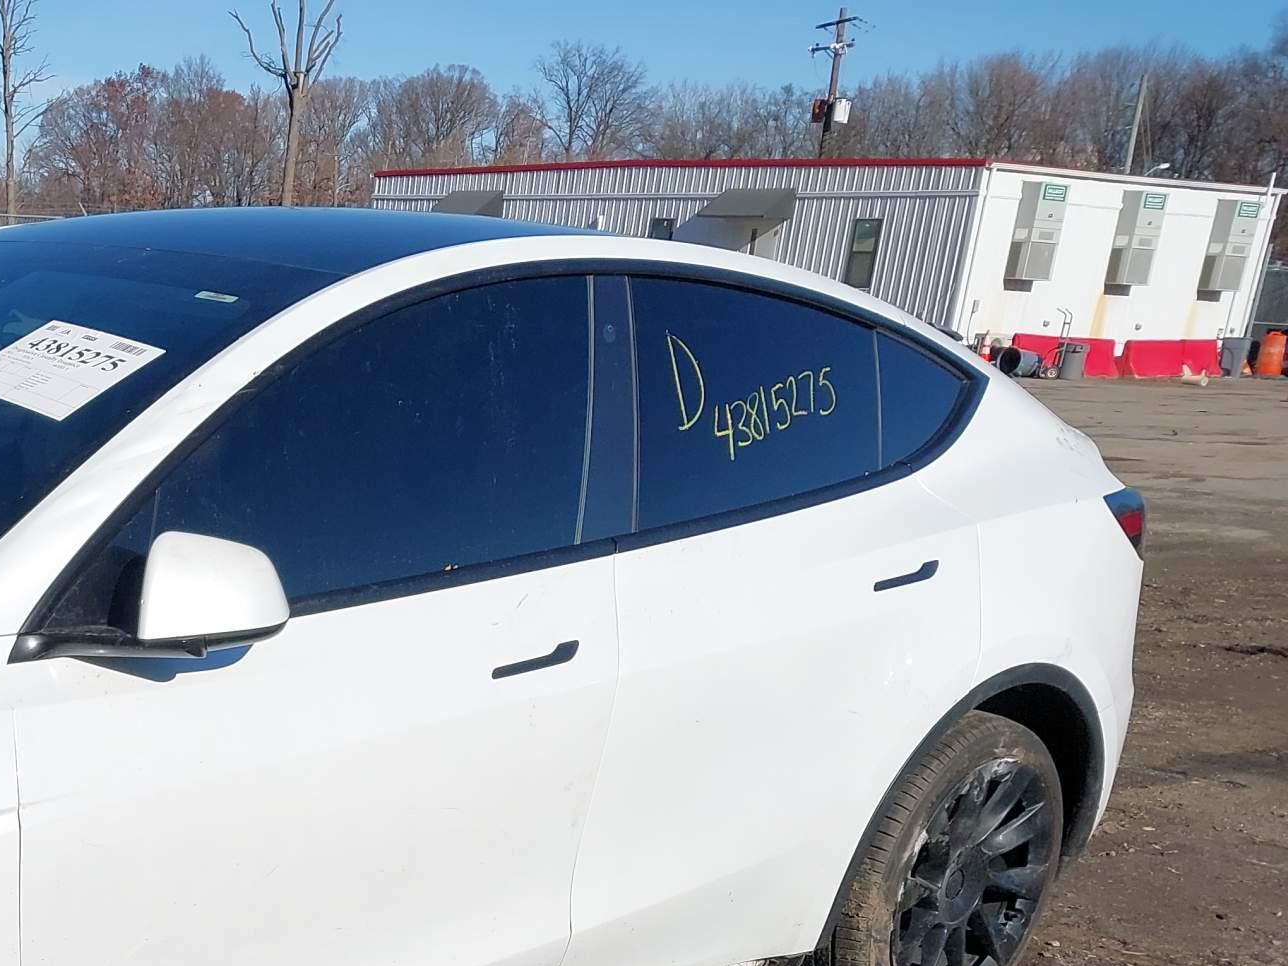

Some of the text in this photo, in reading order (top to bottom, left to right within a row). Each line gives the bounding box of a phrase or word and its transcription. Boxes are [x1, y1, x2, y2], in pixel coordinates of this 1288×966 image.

[28, 337, 127, 372] 43815275
[665, 330, 837, 461] D 43815275
